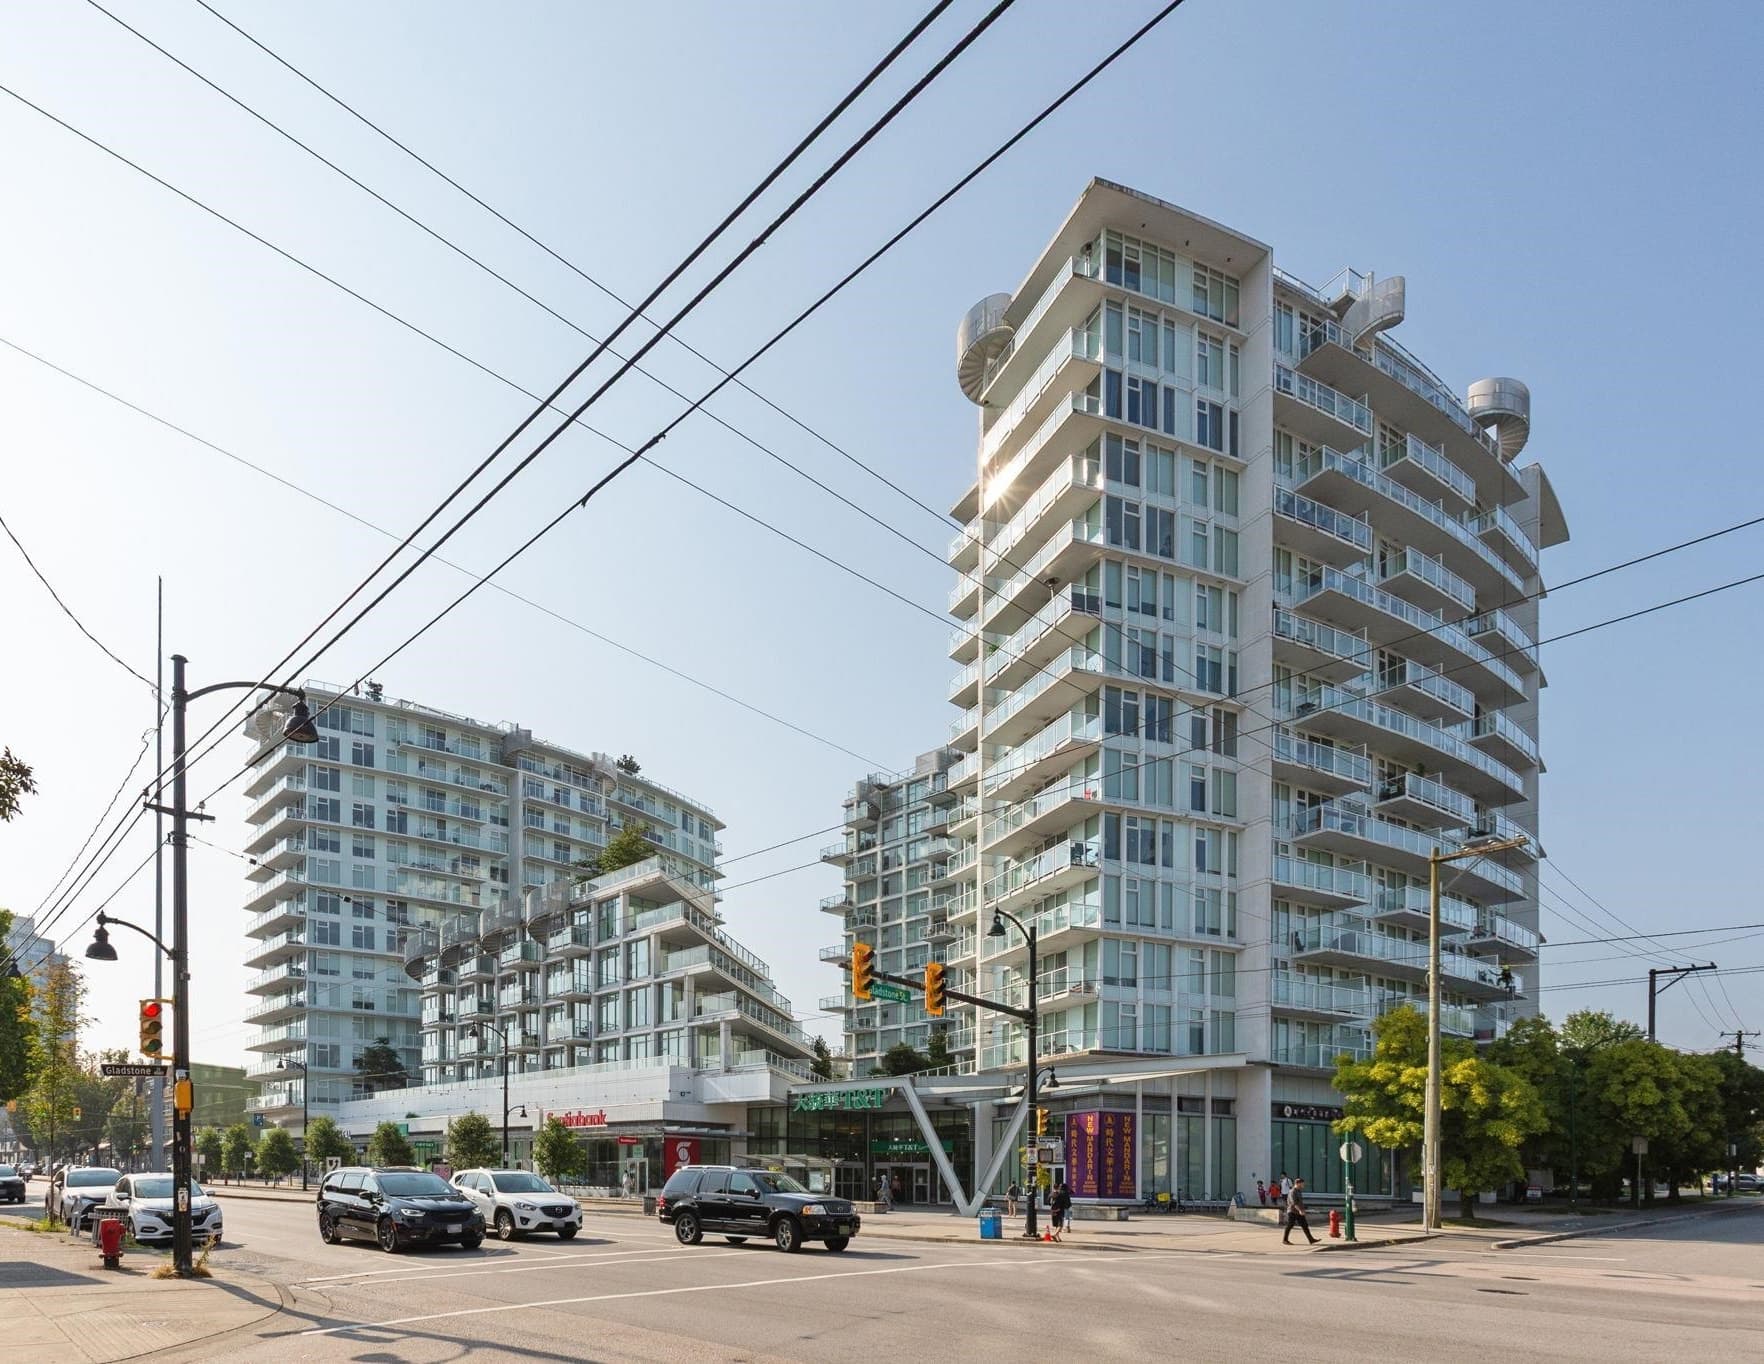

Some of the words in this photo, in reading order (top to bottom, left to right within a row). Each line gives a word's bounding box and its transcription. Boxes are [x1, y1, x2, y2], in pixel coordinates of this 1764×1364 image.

[105, 1066, 152, 1075] Gladstone
[841, 1087, 886, 1110] T&T
[1123, 1135, 1131, 1181] MANDARIN
